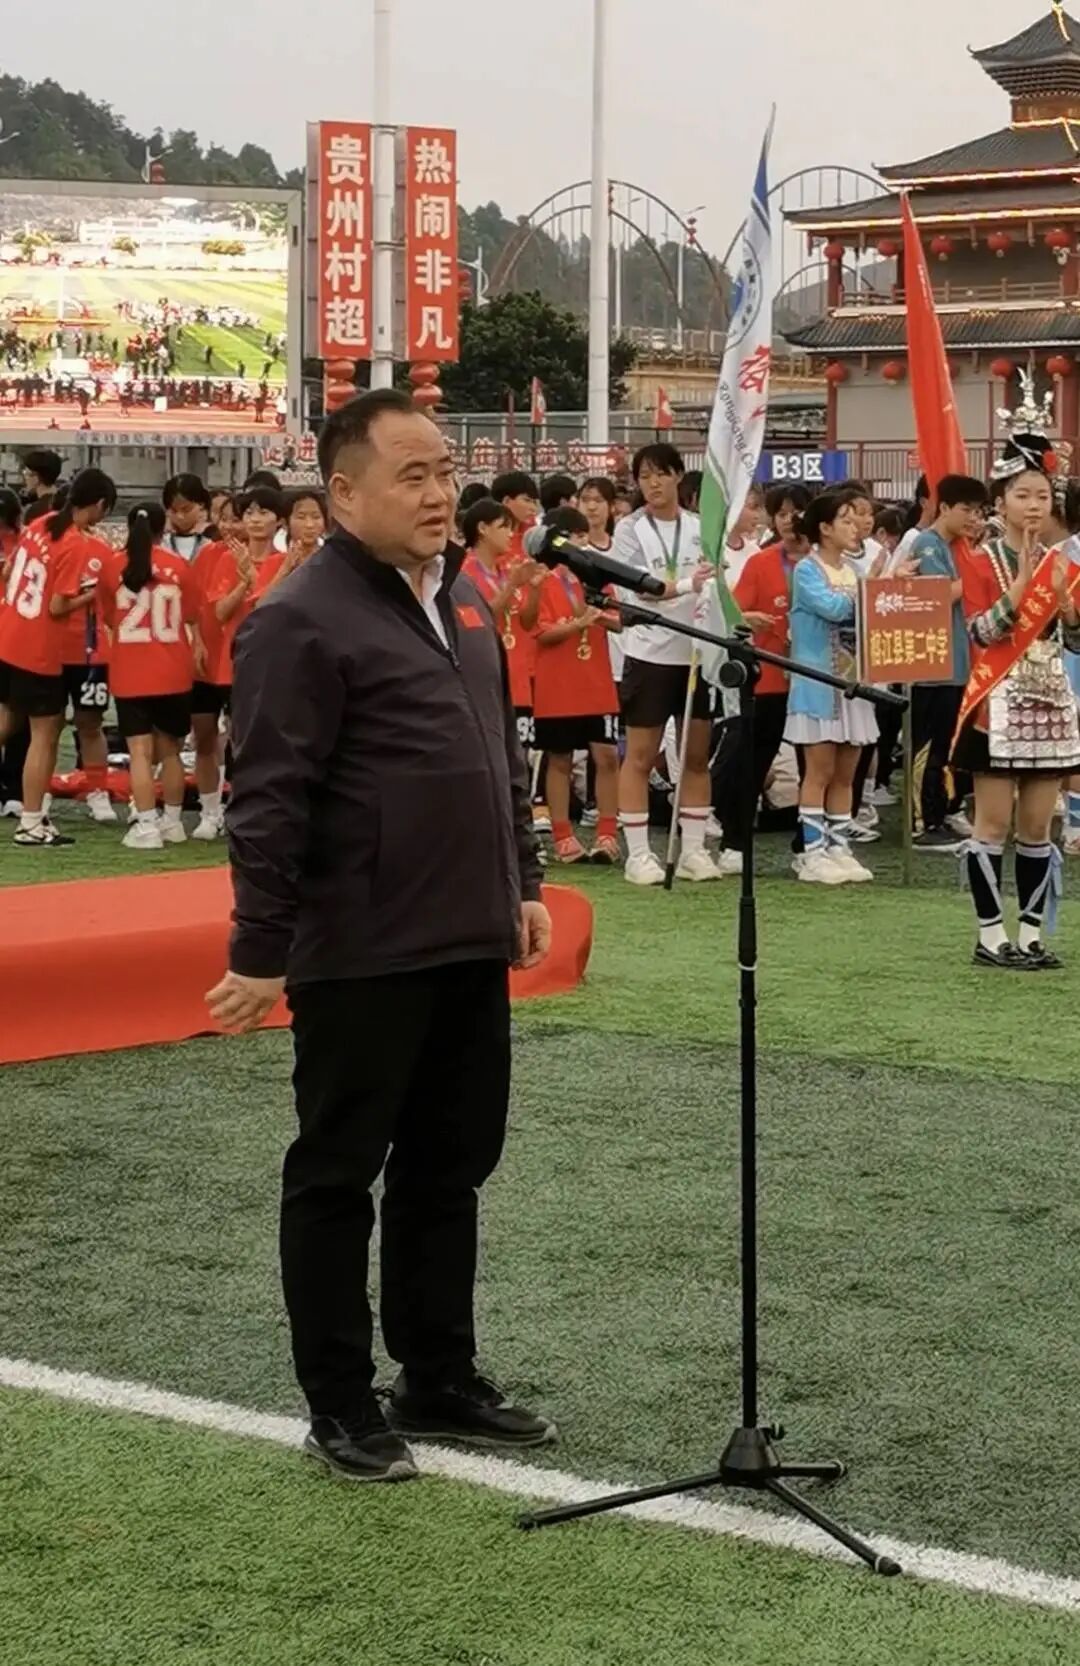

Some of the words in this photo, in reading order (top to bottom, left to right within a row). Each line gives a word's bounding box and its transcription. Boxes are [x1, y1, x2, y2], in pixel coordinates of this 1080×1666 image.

[325, 133, 367, 346] 贵州村超
[414, 138, 452, 349] 热闹非凡
[772, 453, 824, 480] B3区
[6, 545, 47, 620] 13
[116, 584, 182, 643] 20
[80, 682, 107, 706] 26
